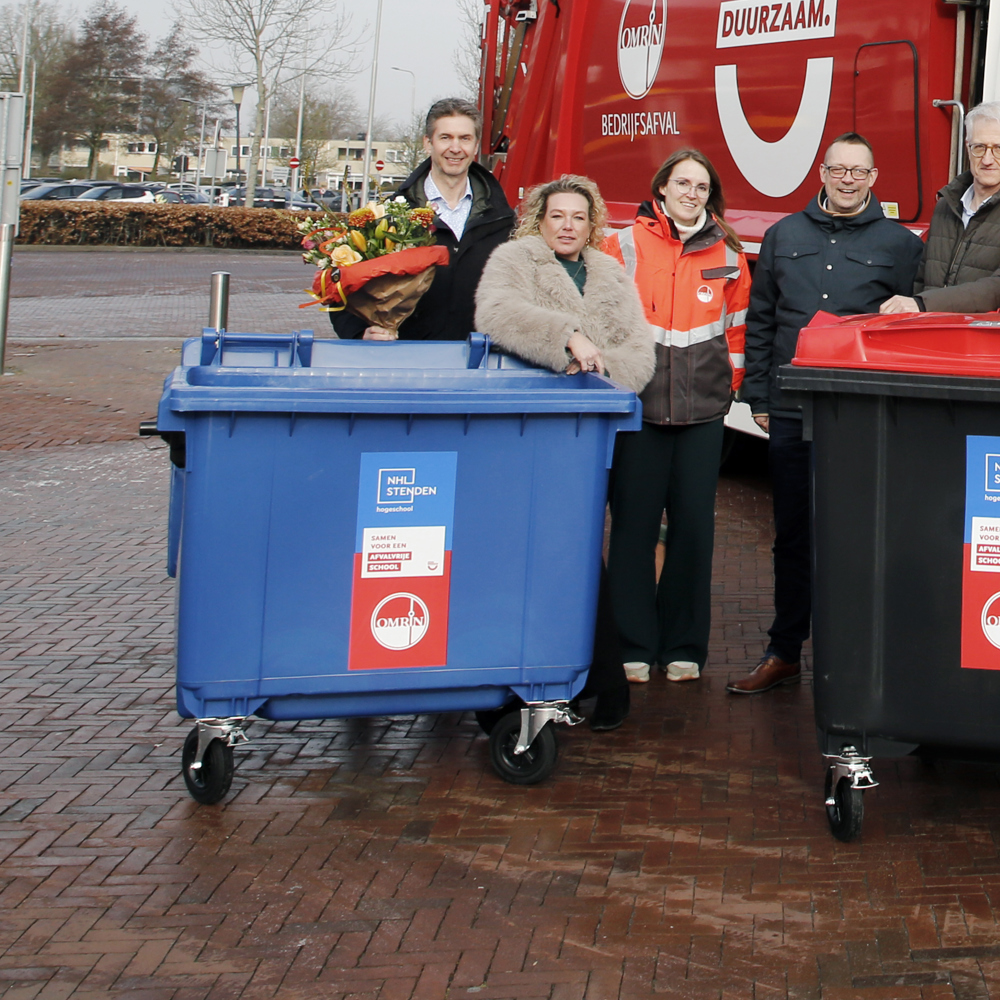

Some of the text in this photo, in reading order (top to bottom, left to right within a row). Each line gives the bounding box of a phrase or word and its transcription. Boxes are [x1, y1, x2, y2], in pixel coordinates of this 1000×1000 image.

[621, 23, 663, 50] OMRIN
[601, 111, 681, 142] BEDRIJFSAFVAL
[387, 475, 413, 485] NHL
[386, 486, 437, 496] STENDEN
[376, 505, 414, 514] hogeschool
[369, 552, 410, 561] AFVALVRIJE
[369, 563, 399, 571] SCHOOL
[375, 615, 425, 628] OMRIN
